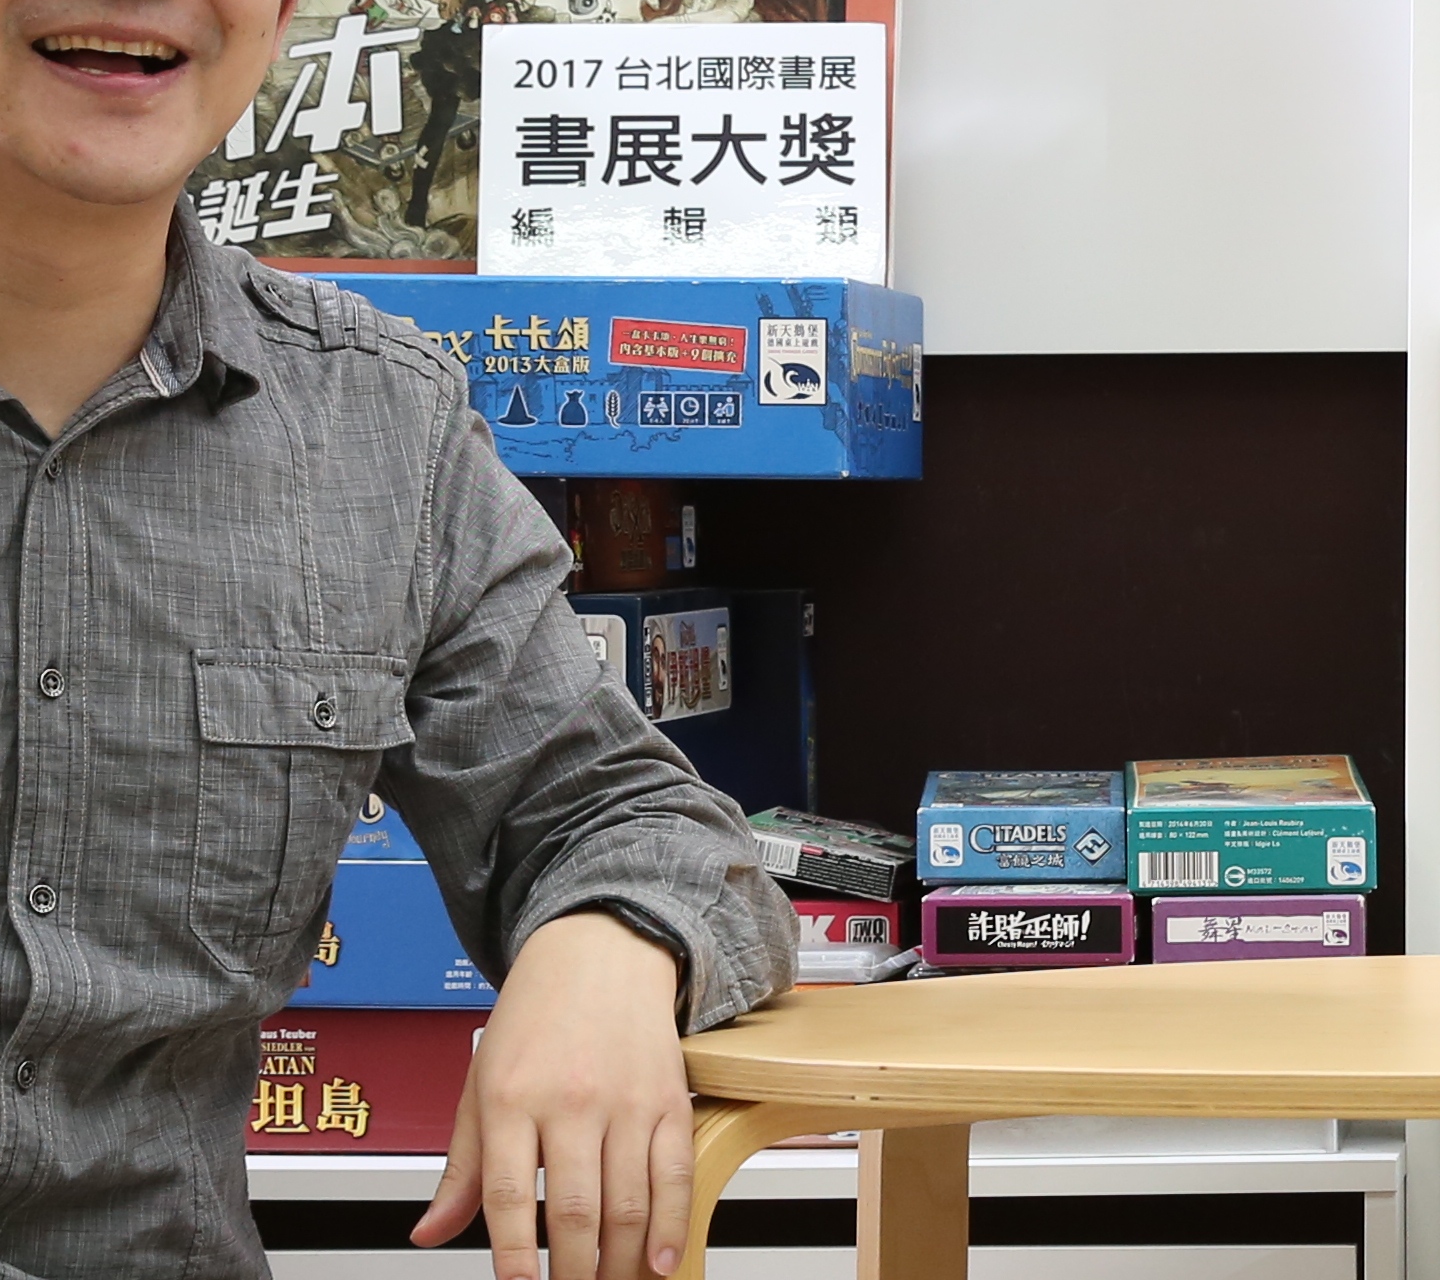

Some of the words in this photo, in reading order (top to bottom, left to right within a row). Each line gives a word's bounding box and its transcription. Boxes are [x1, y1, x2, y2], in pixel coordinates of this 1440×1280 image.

[513, 59, 603, 89] 2017
[614, 55, 857, 91] 台北國際書展
[515, 113, 857, 187] 書展大獎
[200, 163, 340, 245] 誕生
[484, 313, 591, 352] 卡卡頌
[766, 323, 819, 338] 新天鵝堡
[484, 356, 591, 375] 2013大盒版
[968, 824, 1067, 853] CITADELS
[997, 853, 1065, 869] 富饒之城
[853, 917, 884, 936] TWO
[280, 1028, 317, 1040] Teuber
[261, 1042, 303, 1053] SIEDLER
[259, 1055, 316, 1076] ATAN
[249, 1077, 371, 1139] 坦島
